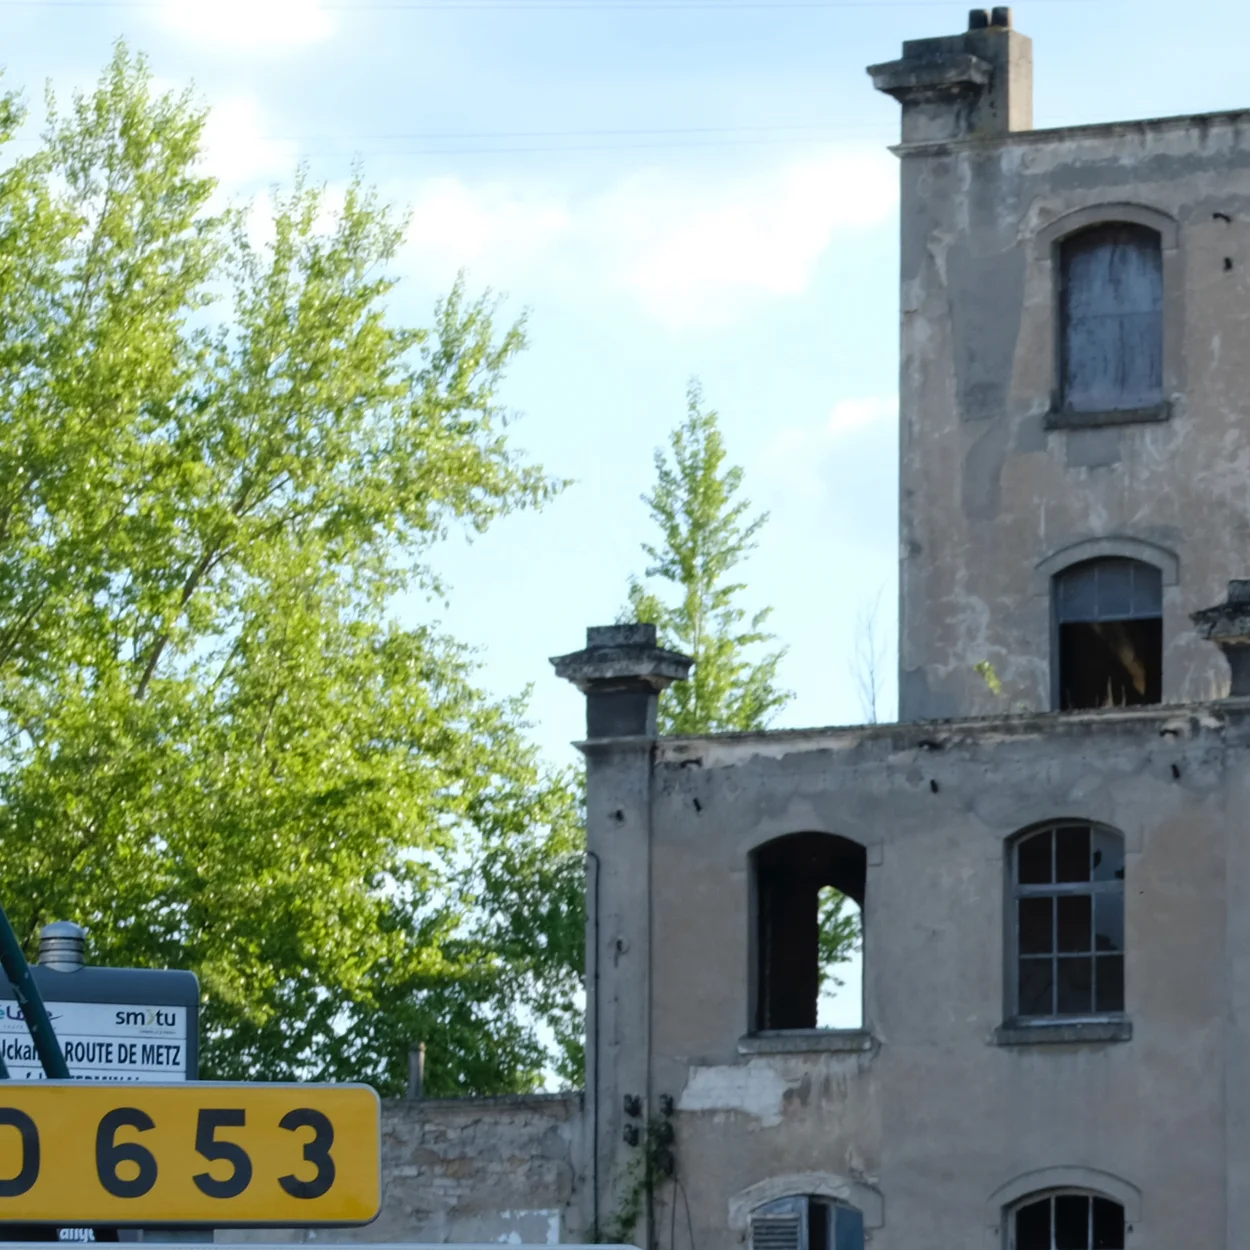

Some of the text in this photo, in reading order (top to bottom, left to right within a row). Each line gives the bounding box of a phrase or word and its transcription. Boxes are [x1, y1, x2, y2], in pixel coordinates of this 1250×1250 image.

[65, 1041, 113, 1063] ROUTE
[118, 1043, 137, 1065] DE
[141, 1044, 181, 1066] METZ
[0, 1106, 336, 1200] D 653
